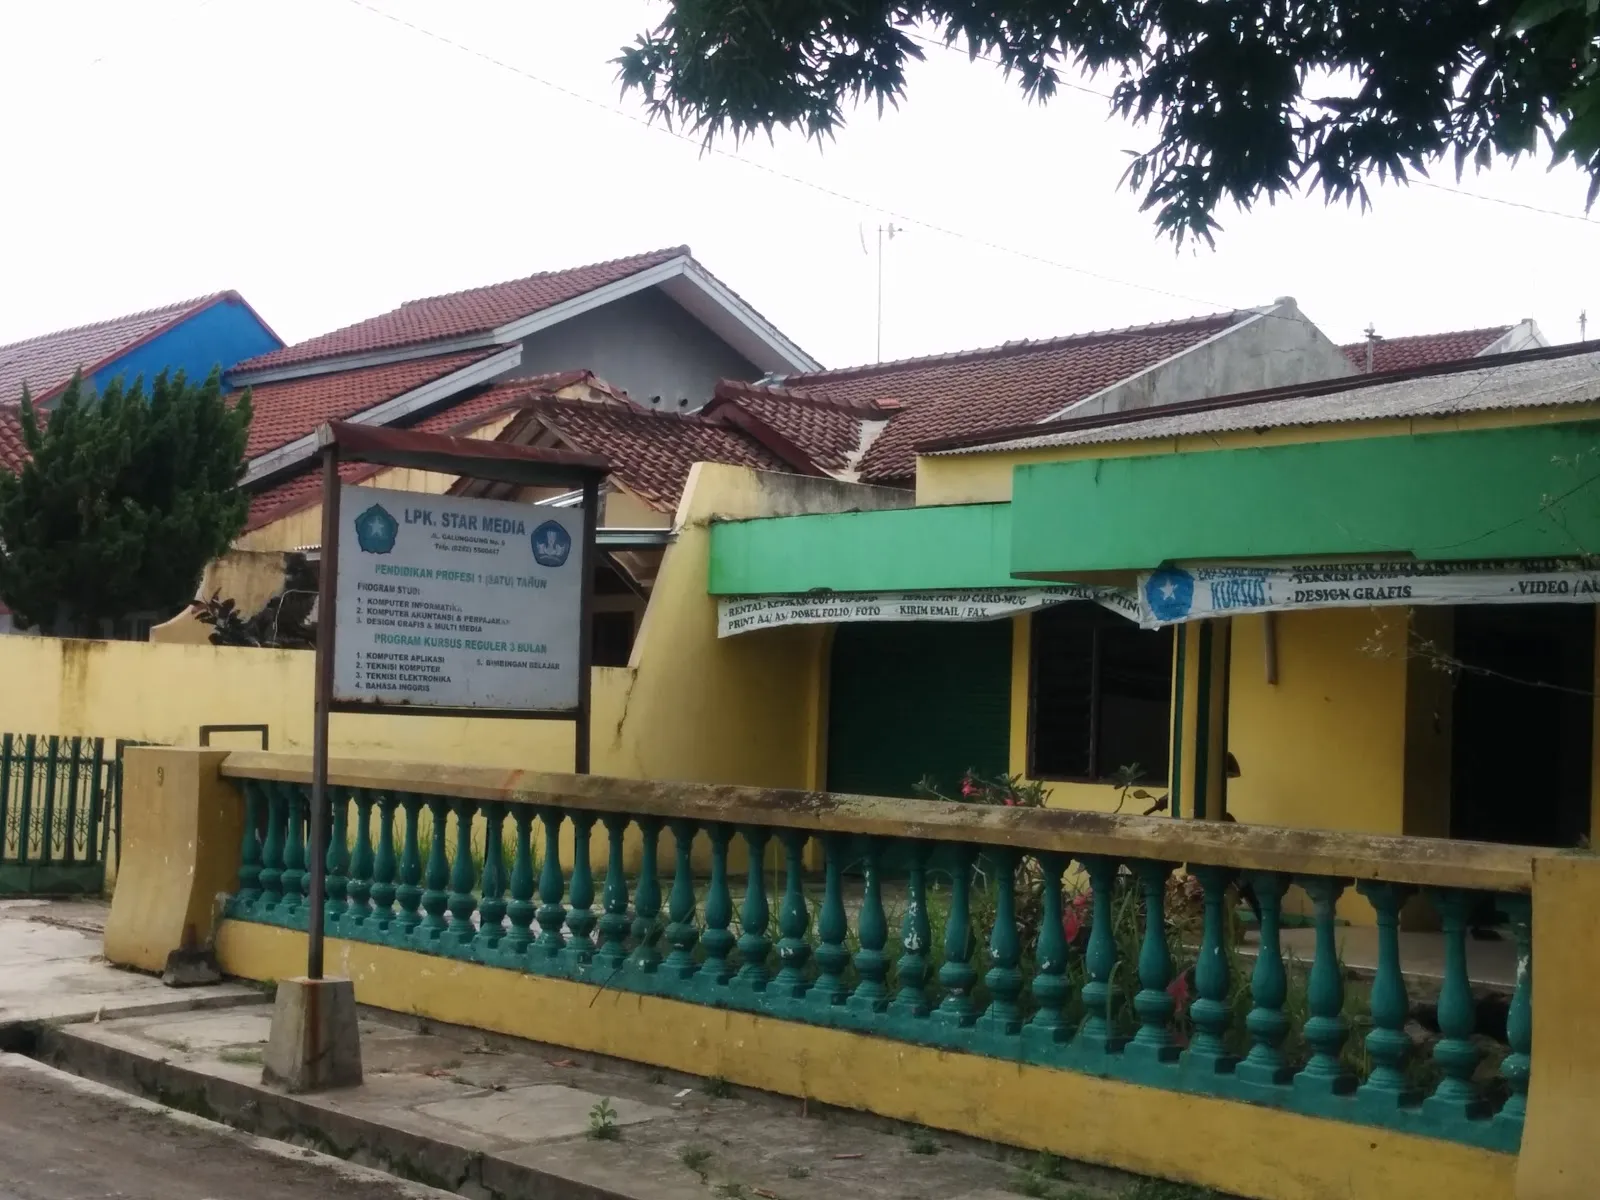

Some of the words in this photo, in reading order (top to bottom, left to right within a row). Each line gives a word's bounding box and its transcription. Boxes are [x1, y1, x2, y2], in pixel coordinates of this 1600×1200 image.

[404, 508, 436, 526] LPK.
[442, 512, 477, 530] STAR
[482, 516, 526, 535] MEDIA
[375, 564, 433, 578] PENDIDIKAN
[435, 570, 474, 583] PROFESI
[517, 577, 547, 589] TAHUN
[357, 582, 395, 592] PROGRAM
[1518, 580, 1569, 595] VIDEO
[1294, 588, 1350, 603] DESIGN
[1352, 585, 1412, 600] GRAFIS
[367, 598, 409, 608] KOMPUTER
[367, 608, 409, 617] KOMPUTER
[411, 612, 454, 621] AKUNTANSI
[900, 605, 928, 615] KIRIM
[930, 605, 960, 616] EMAIL
[728, 616, 754, 630] PRINT
[790, 608, 821, 619] DOBEL
[855, 606, 881, 616] FOTO
[366, 618, 395, 626] DESIGN
[397, 620, 424, 629] GRAFIS
[434, 622, 457, 630] MULTI
[459, 624, 483, 632] MEDIA
[374, 633, 421, 646] PROGRAM
[424, 636, 462, 649] KURSUS
[465, 639, 507, 652] REGULER
[509, 642, 515, 652] 3
[517, 642, 547, 654] BULAN
[366, 652, 408, 661] KOMPUTER
[411, 655, 445, 663] APLIKASI
[366, 662, 397, 670] TEKNISI
[399, 664, 440, 673] KOMPUTER
[486, 660, 528, 668] BIMBINGAN
[529, 661, 560, 670] BELAJAR
[366, 672, 397, 680] TEKNISI
[399, 674, 451, 683] ELEKTRONIKA
[365, 682, 397, 690] BAHASA
[399, 684, 430, 692] INGGRIS
